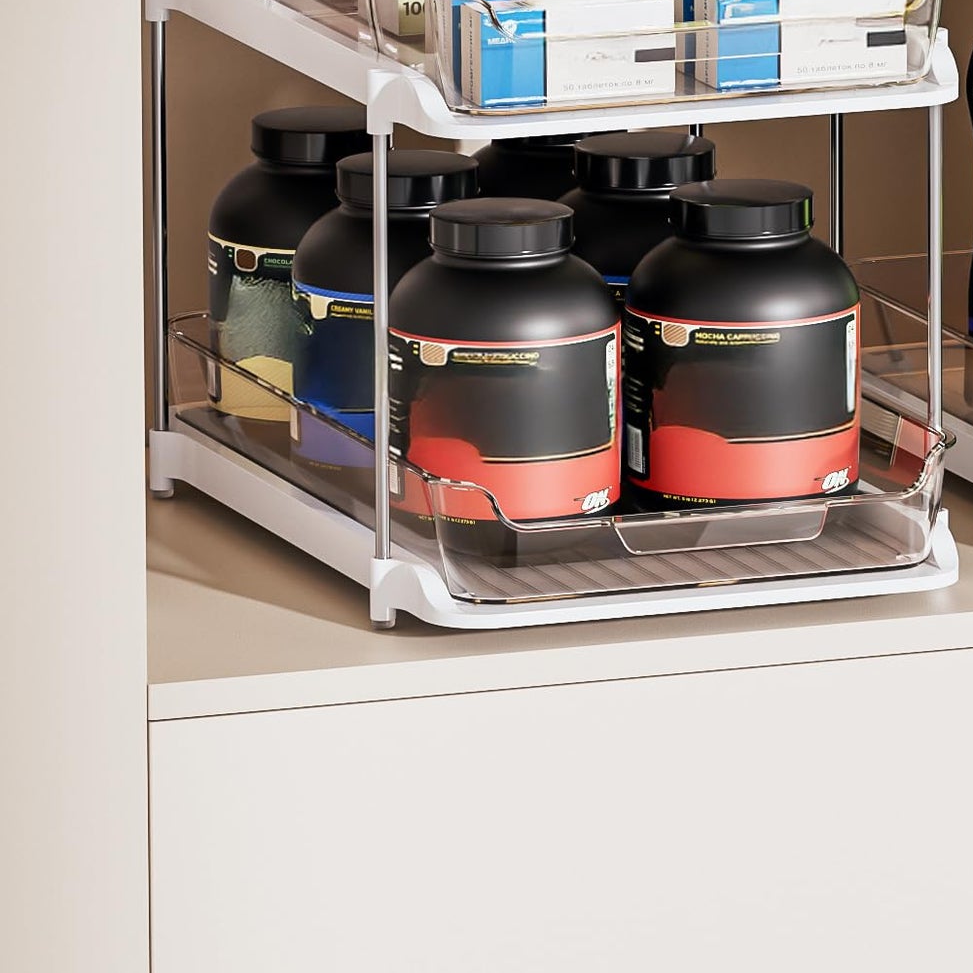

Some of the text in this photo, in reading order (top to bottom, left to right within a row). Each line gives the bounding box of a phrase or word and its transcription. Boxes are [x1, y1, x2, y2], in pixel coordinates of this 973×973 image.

[403, 1, 425, 16] 10
[330, 304, 354, 313] CREAMY
[694, 332, 725, 340] MOCHA
